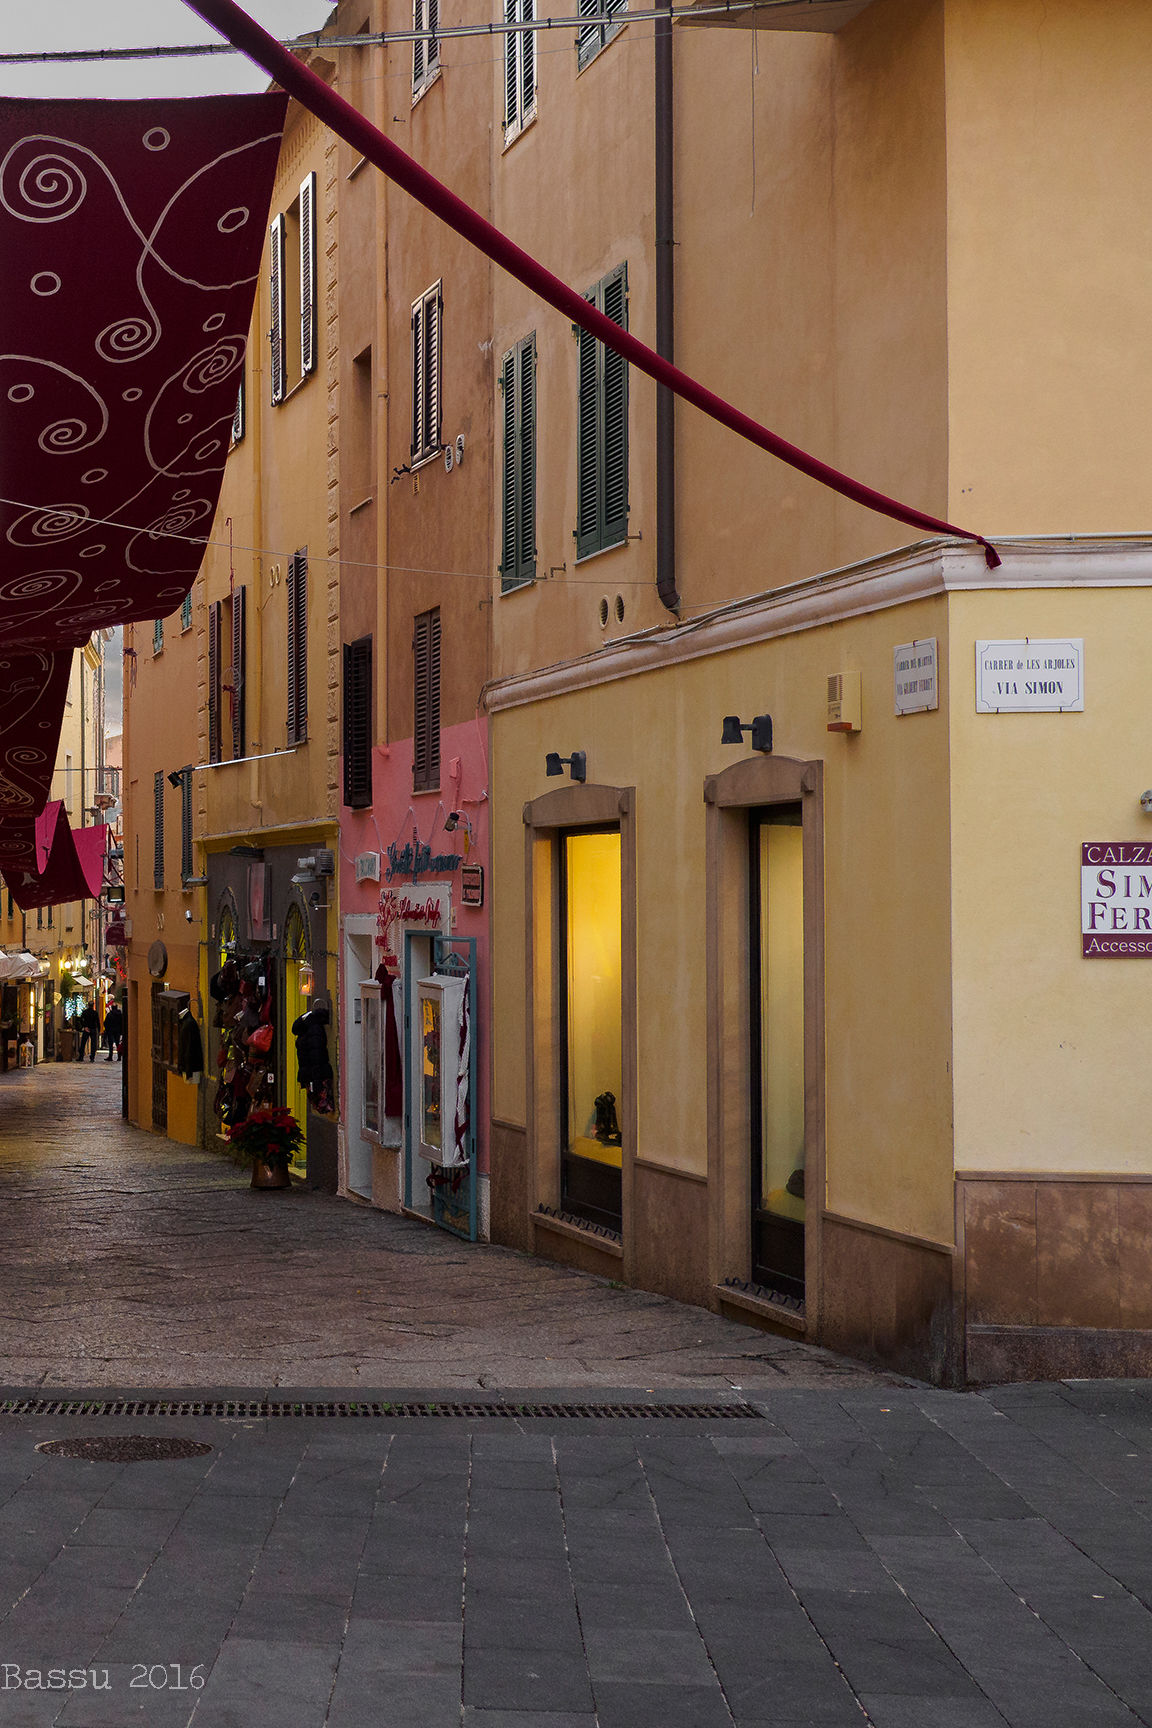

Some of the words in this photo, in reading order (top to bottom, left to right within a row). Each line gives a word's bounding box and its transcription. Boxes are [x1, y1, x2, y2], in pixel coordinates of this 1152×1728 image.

[984, 660, 1014, 670] CARRER
[1016, 660, 1024, 670] de
[1026, 659, 1040, 670] LES
[1044, 658, 1075, 670] ARJOLES
[997, 682, 1018, 695] VIA
[1025, 681, 1063, 695] SIMON
